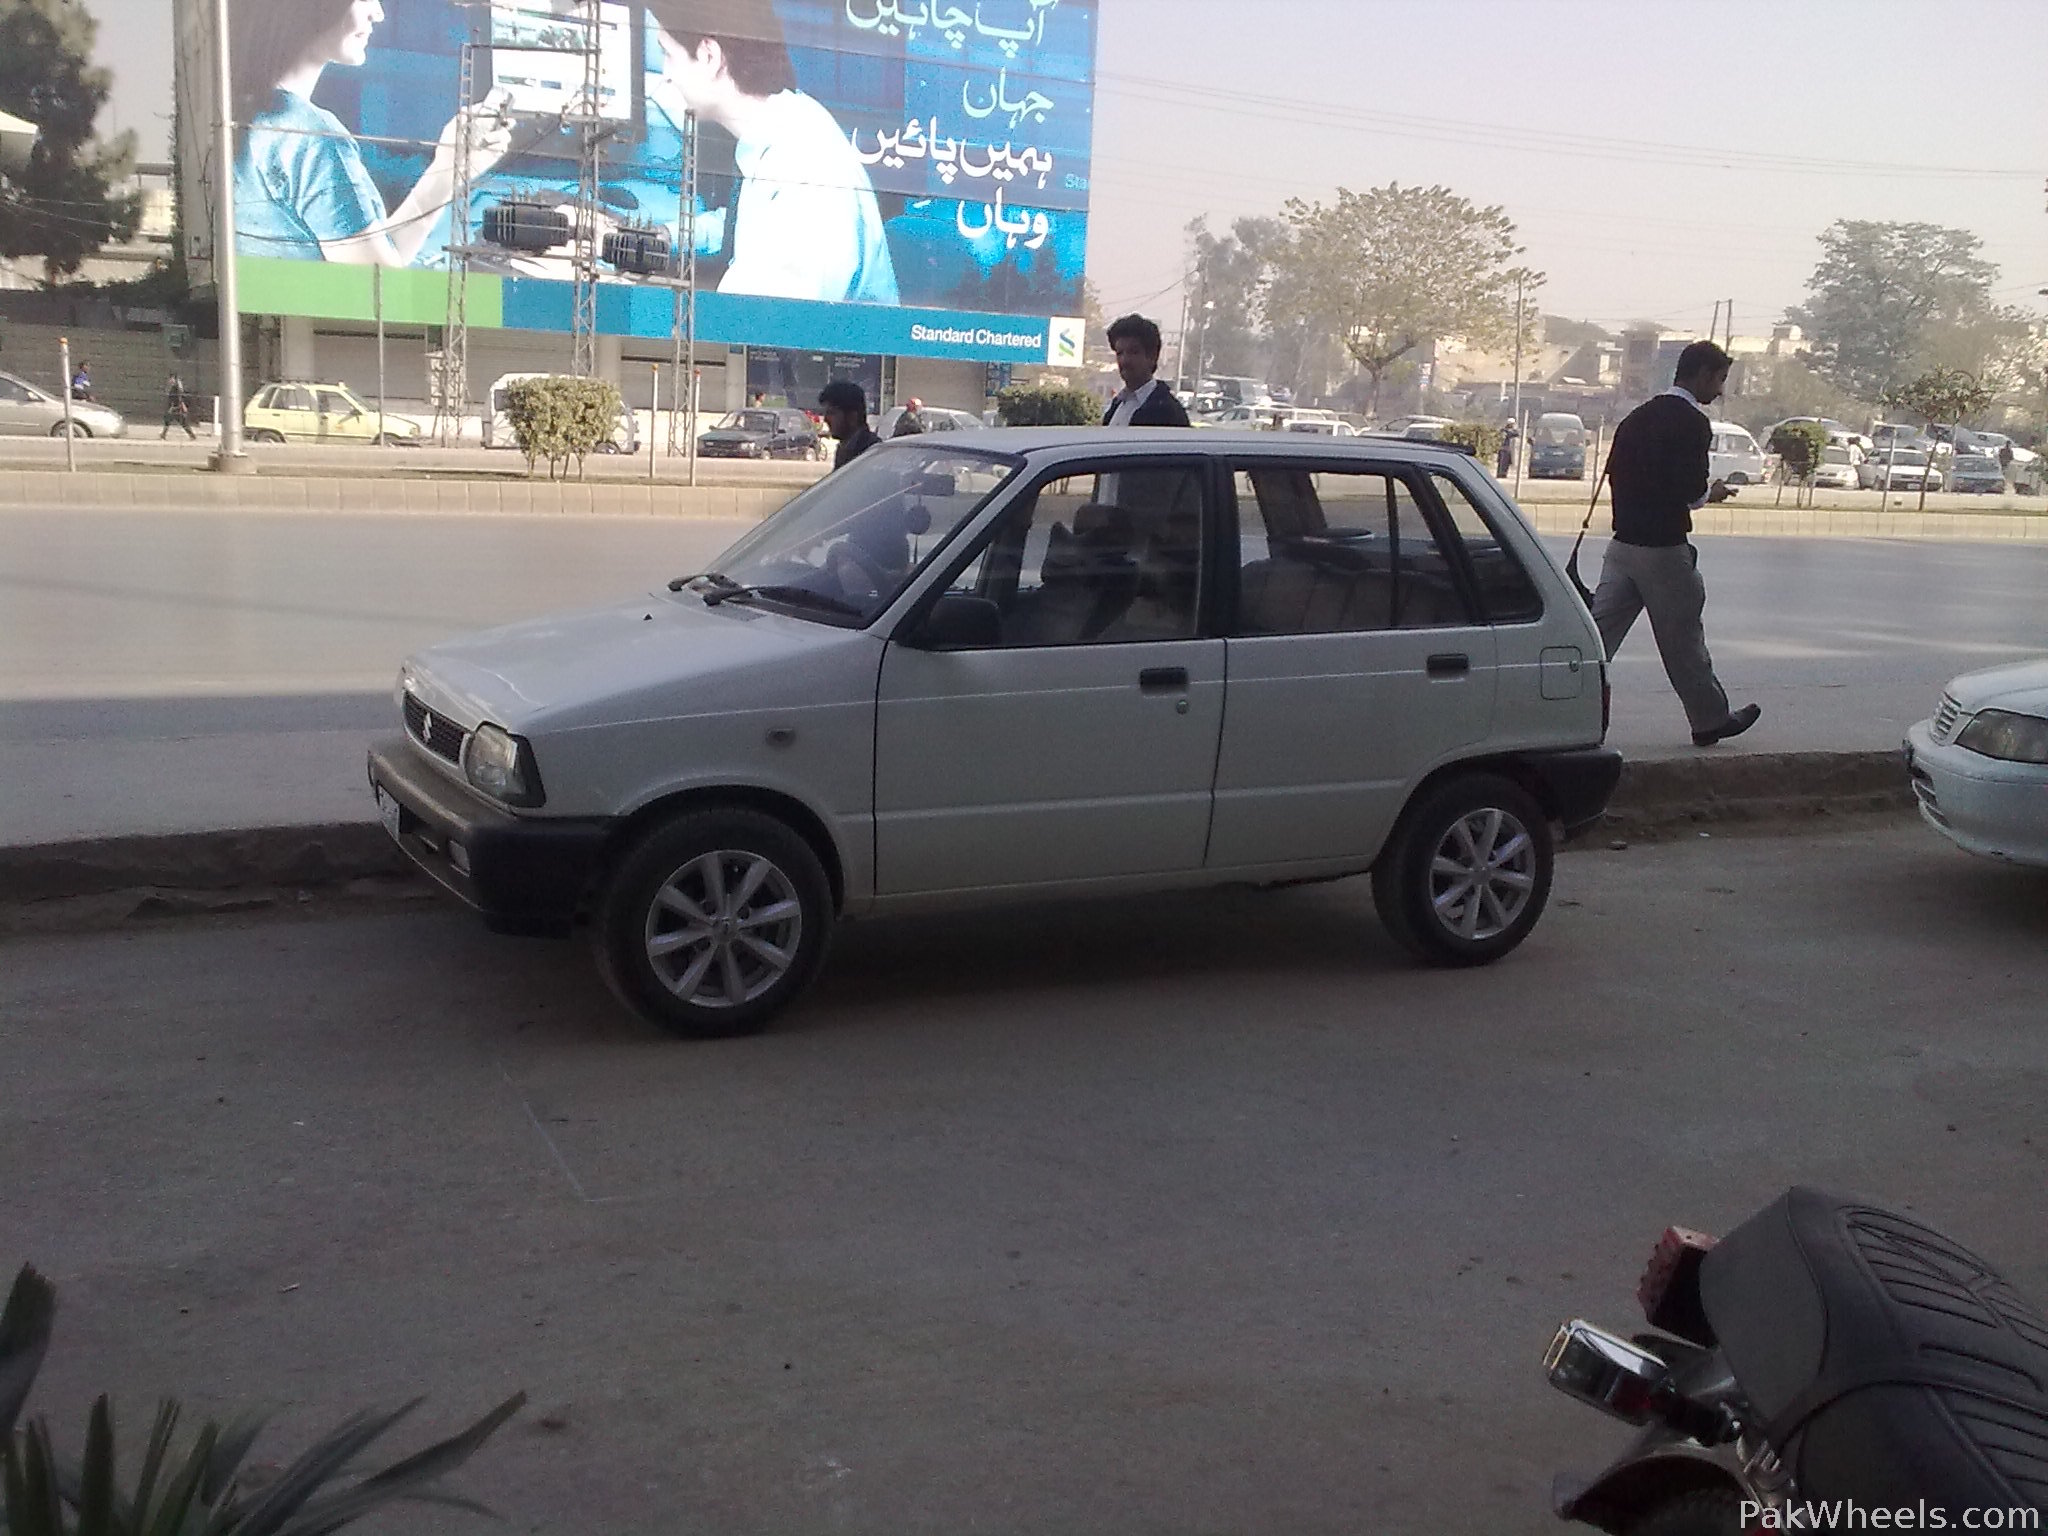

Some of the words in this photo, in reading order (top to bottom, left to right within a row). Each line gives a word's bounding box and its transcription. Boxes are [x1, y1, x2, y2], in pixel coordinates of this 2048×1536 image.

[963, 66, 1054, 128] جہاں
[852, 116, 958, 184] پائیں
[959, 140, 1052, 189] ہمیں
[910, 324, 974, 344] Standard
[975, 328, 1042, 348] Chartered
